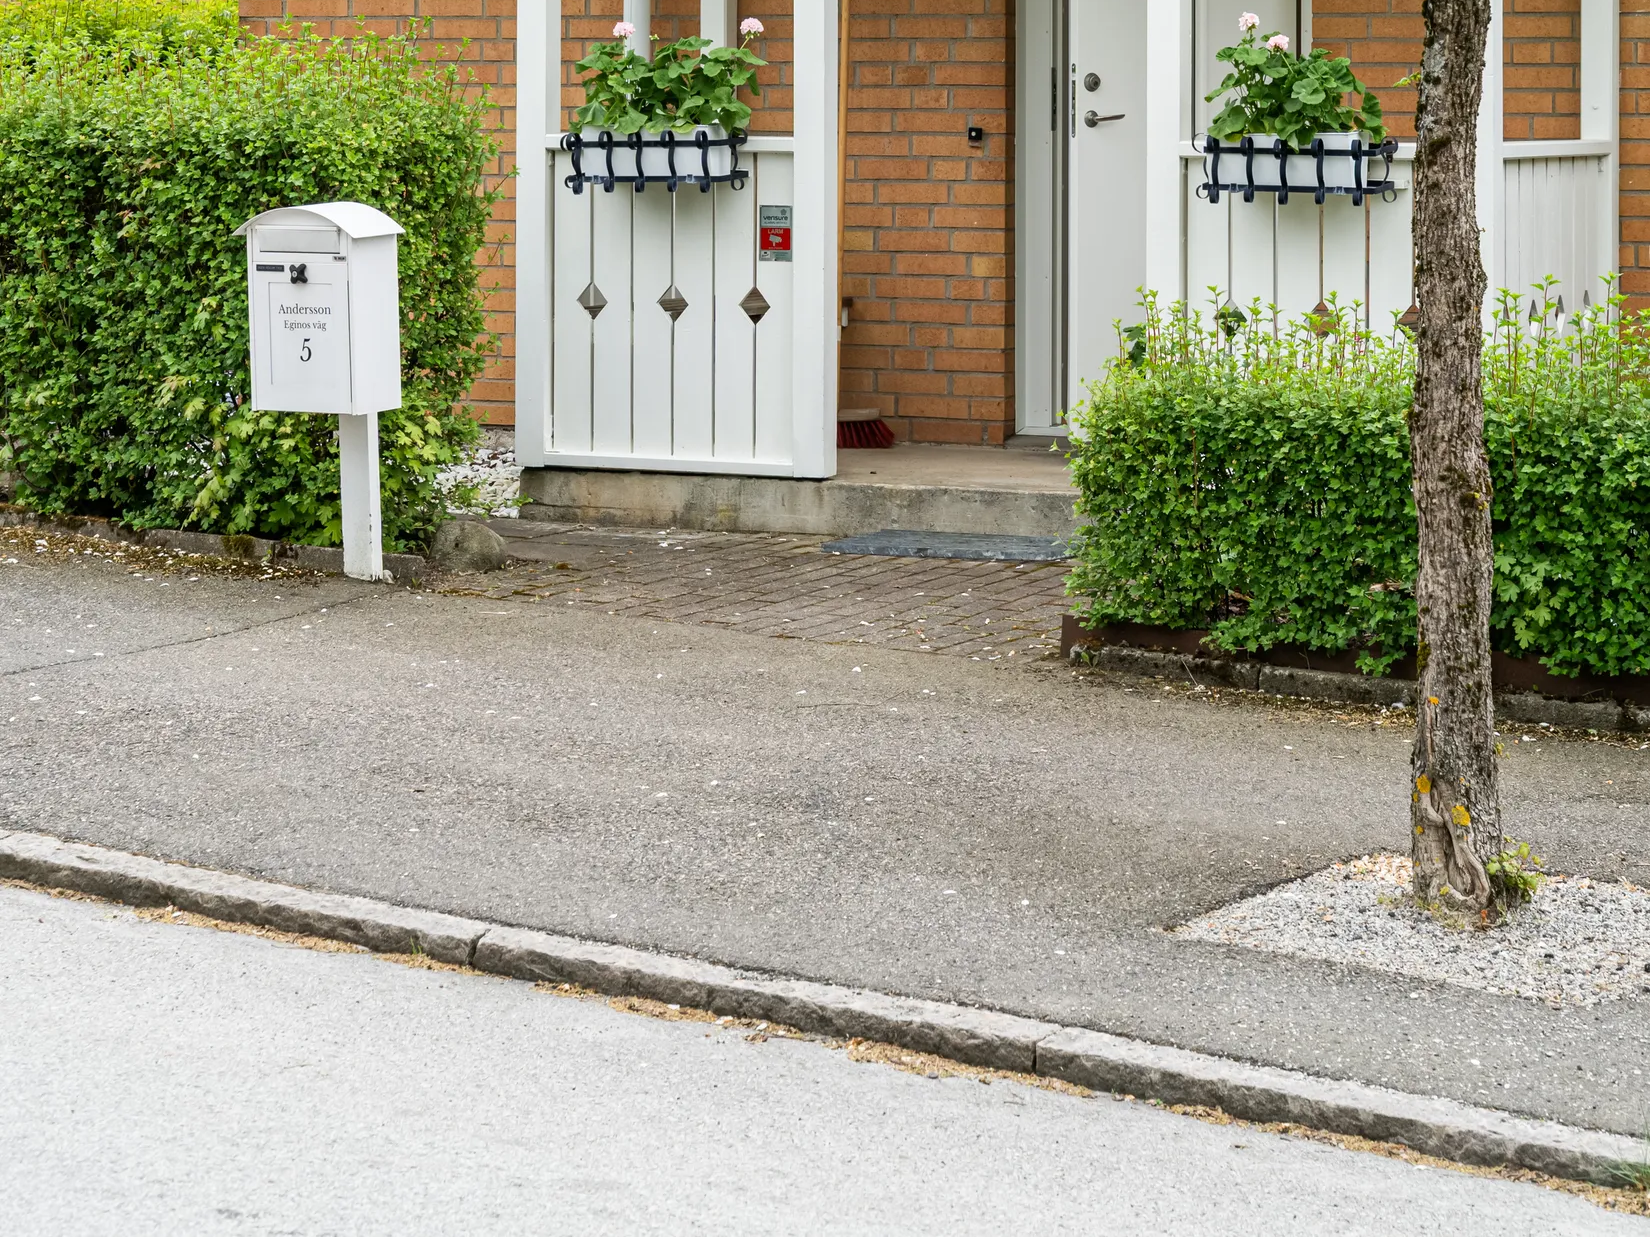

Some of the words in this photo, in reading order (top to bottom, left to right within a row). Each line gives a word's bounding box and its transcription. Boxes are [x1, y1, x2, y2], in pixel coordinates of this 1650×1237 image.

[278, 303, 331, 314] Andersson
[284, 319, 311, 331] Eginos
[312, 320, 327, 332] väg
[300, 338, 312, 362] 5
